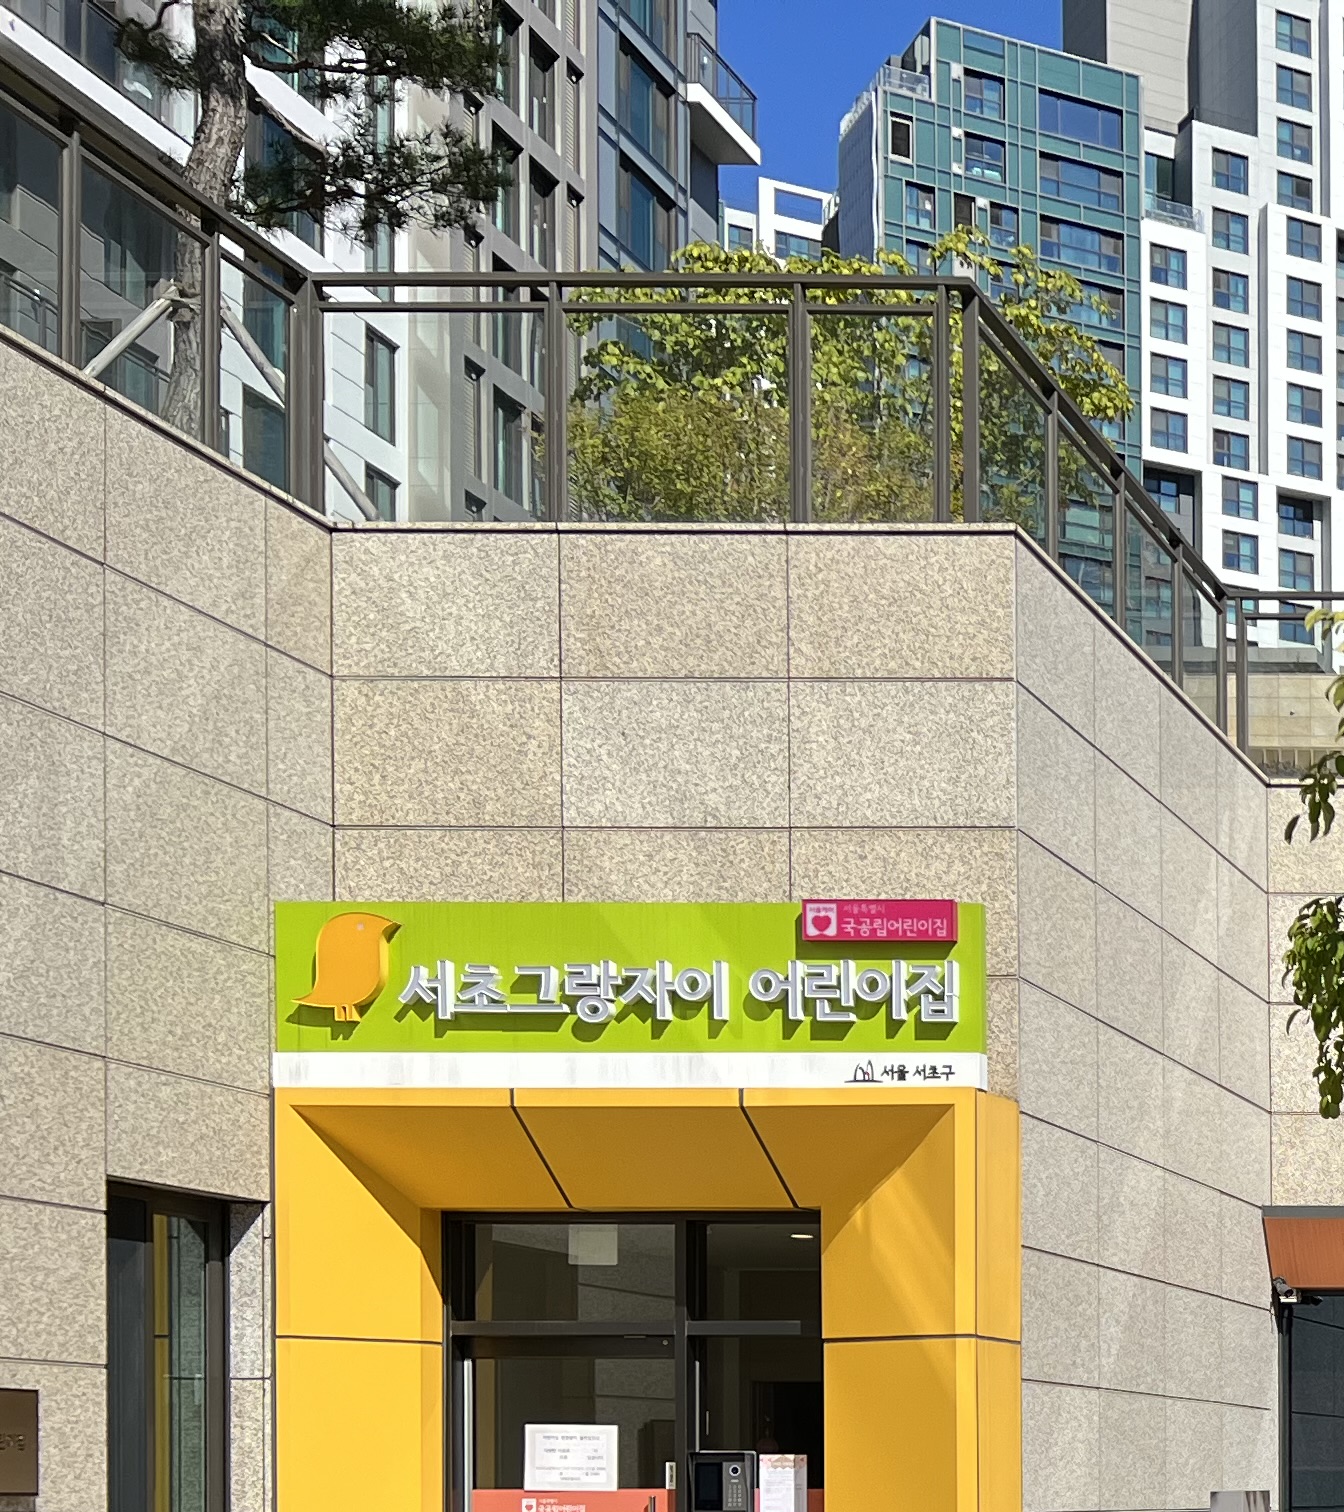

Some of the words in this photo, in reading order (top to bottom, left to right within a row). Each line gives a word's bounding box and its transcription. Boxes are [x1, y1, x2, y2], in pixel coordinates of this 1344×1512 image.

[842, 903, 885, 914] 서울특별시
[841, 917, 947, 937] 국공립어린이집
[399, 959, 730, 1024] 서초그랑자이
[749, 959, 960, 1023] 어린이집
[880, 1063, 909, 1081] 서울
[912, 1063, 956, 1081] 서초구
